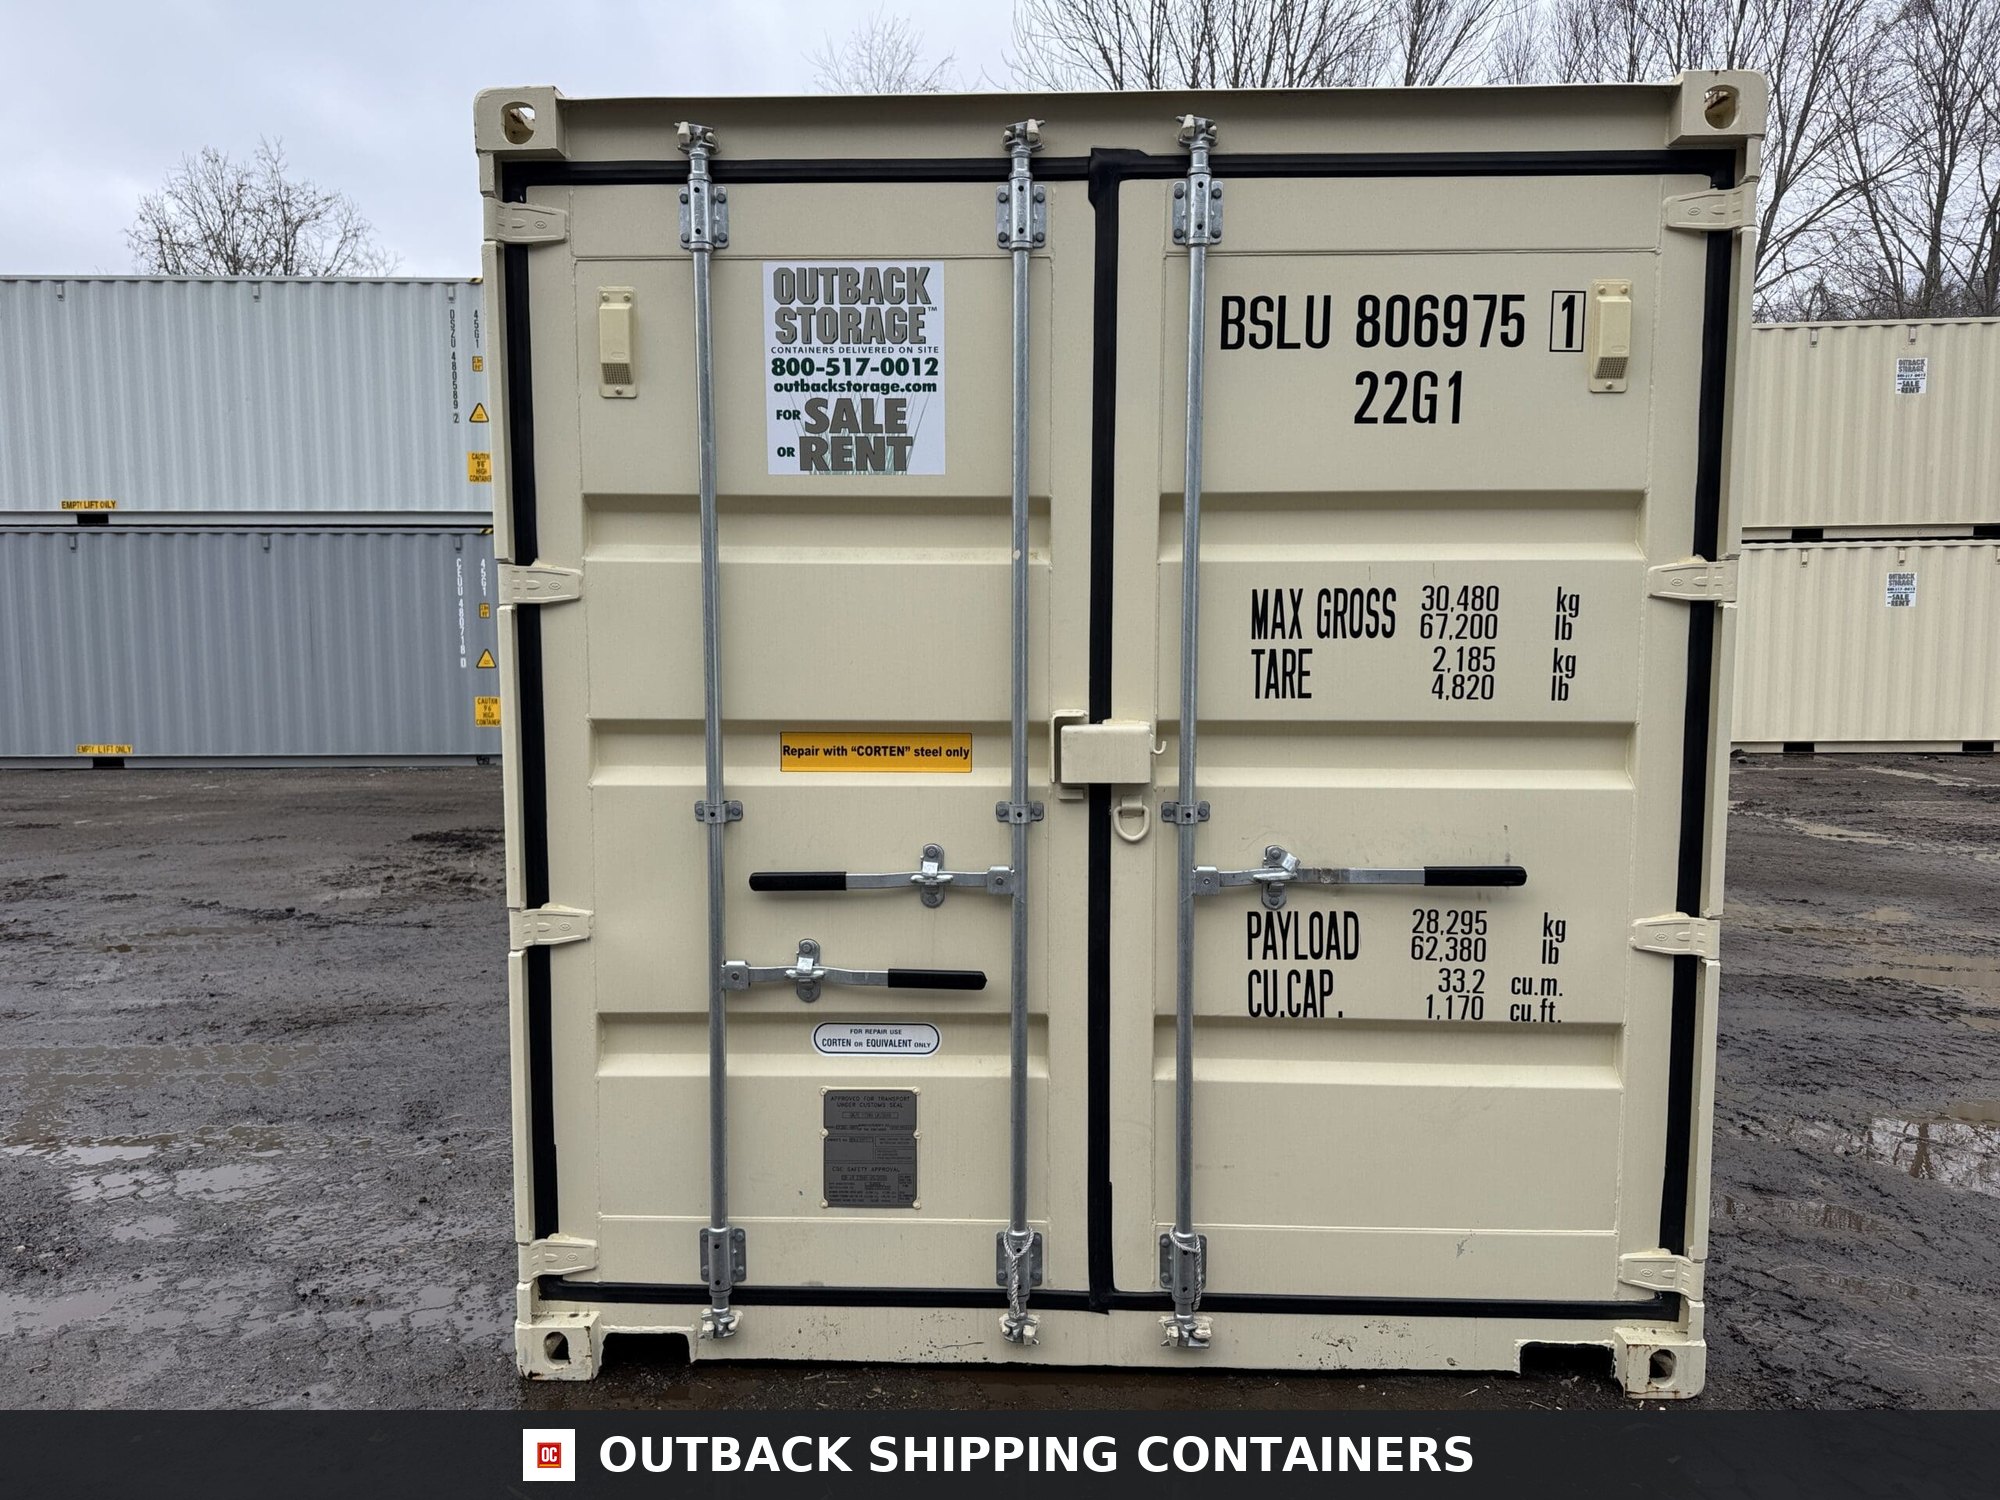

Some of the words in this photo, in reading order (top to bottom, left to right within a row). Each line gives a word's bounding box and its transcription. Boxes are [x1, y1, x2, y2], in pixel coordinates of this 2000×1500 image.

[773, 266, 932, 305] OUTBACK
[1221, 295, 1331, 350] BSLU
[1356, 295, 1525, 348] 806975
[1561, 294, 1575, 349] 1
[771, 346, 835, 354] CONTAINERS
[838, 346, 895, 354] DELIVERED
[898, 346, 914, 354] ON
[917, 346, 939, 354] SITE
[451, 351, 459, 409] 480589
[771, 357, 939, 377] 800-517-0012
[773, 378, 937, 395] outbackstorage.com
[1354, 371, 1462, 424] 22G1
[776, 409, 801, 420] FOR
[804, 397, 907, 434] SALE
[777, 447, 795, 457] OR
[799, 436, 913, 472] RENT
[1252, 589, 1303, 639] MAX
[1317, 588, 1396, 639] GROSS
[1421, 585, 1500, 613] 30,480
[1554, 585, 1581, 618] kg
[1419, 613, 1499, 641] 67,200
[1554, 614, 1573, 641] lb
[1251, 649, 1312, 699] TARE
[1431, 645, 1497, 673] 2,185
[1552, 646, 1577, 679] kg
[1430, 674, 1495, 701] 4,820
[1549, 675, 1570, 702] lb
[783, 744, 820, 759] Repair
[823, 744, 848, 757] with
[851, 744, 911, 758] “CORTEN”
[914, 745, 943, 758] steel
[945, 745, 970, 760] only
[1247, 911, 1360, 961] PAYLOAD
[1410, 908, 1489, 936] 28,295
[1543, 911, 1567, 943] kg
[1410, 936, 1487, 963] 62,380
[1541, 939, 1560, 965] lb
[1437, 967, 1486, 995] 33.2
[1510, 974, 1565, 998] cu.m.
[1426, 994, 1485, 1021] 1,170
[1509, 998, 1563, 1024] cu.ft.
[821, 1038, 852, 1048] CORTEN
[866, 1038, 913, 1049] EQUIVALENT
